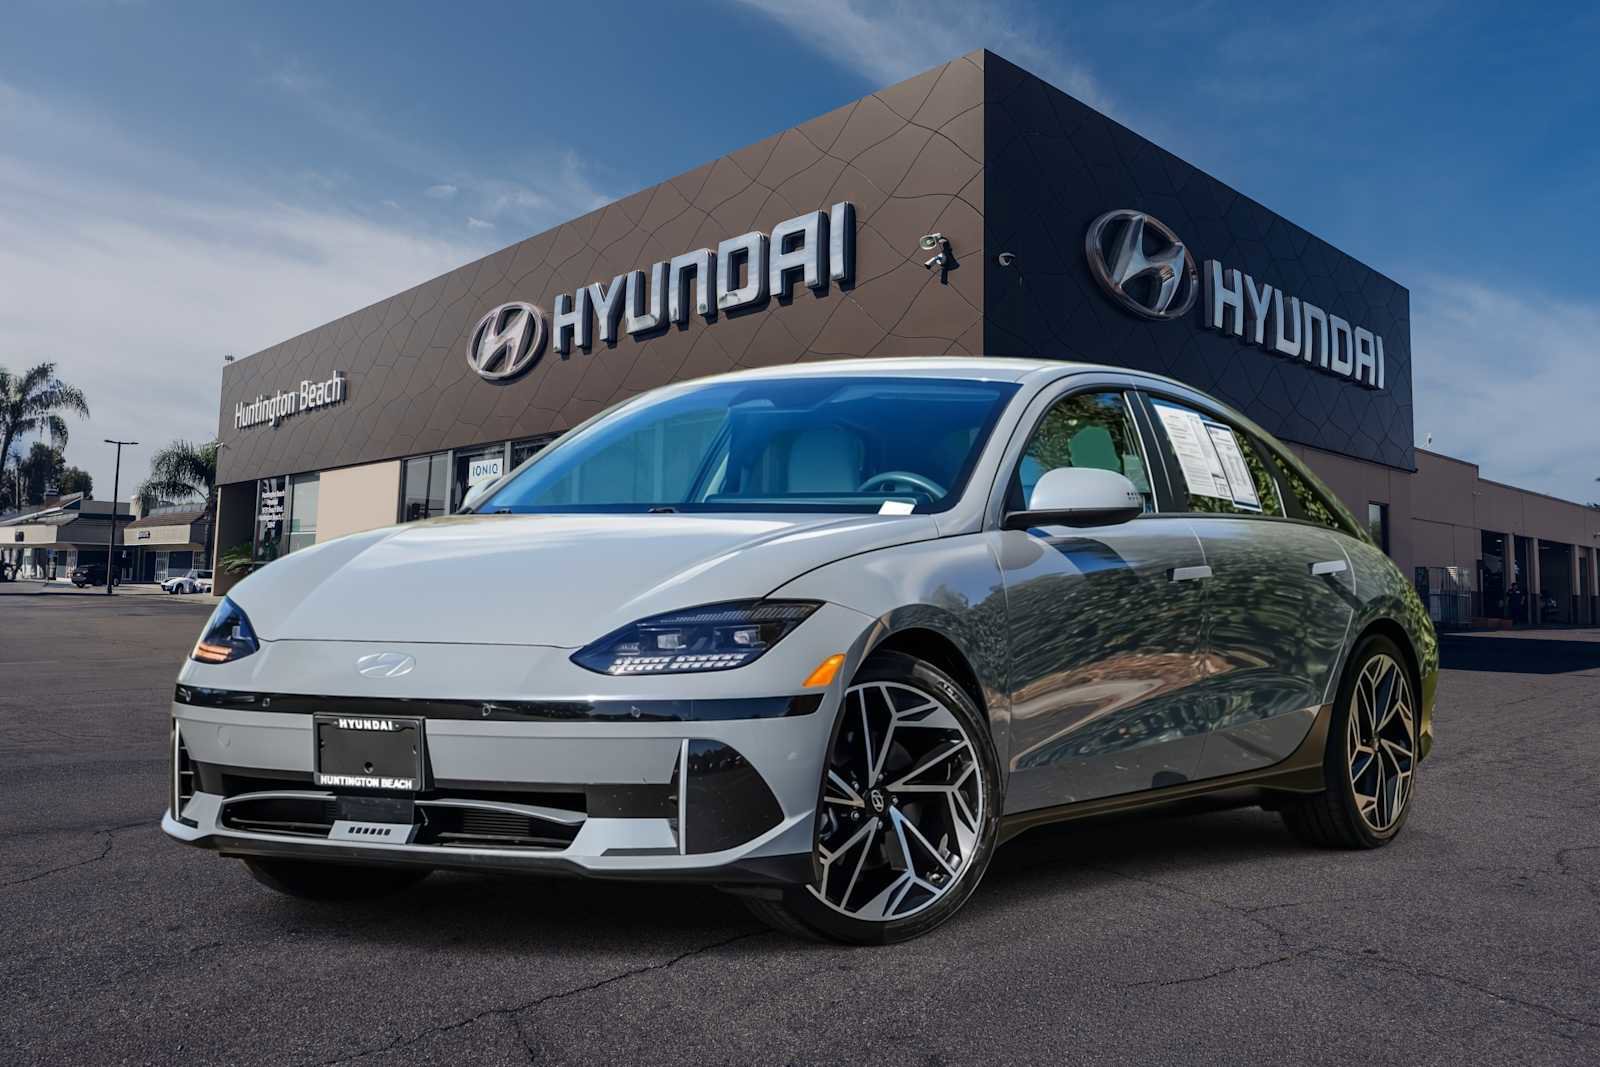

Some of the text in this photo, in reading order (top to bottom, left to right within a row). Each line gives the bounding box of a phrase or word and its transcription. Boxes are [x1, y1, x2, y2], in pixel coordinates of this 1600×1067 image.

[552, 201, 854, 354] HYUNDAI
[1206, 258, 1386, 390] HYUNDAI
[234, 369, 344, 430] Huntington Beach
[472, 463, 499, 477] IONIQ
[338, 718, 393, 731] HYUNDAI
[320, 775, 413, 790] HUNTINGTON BEACH
